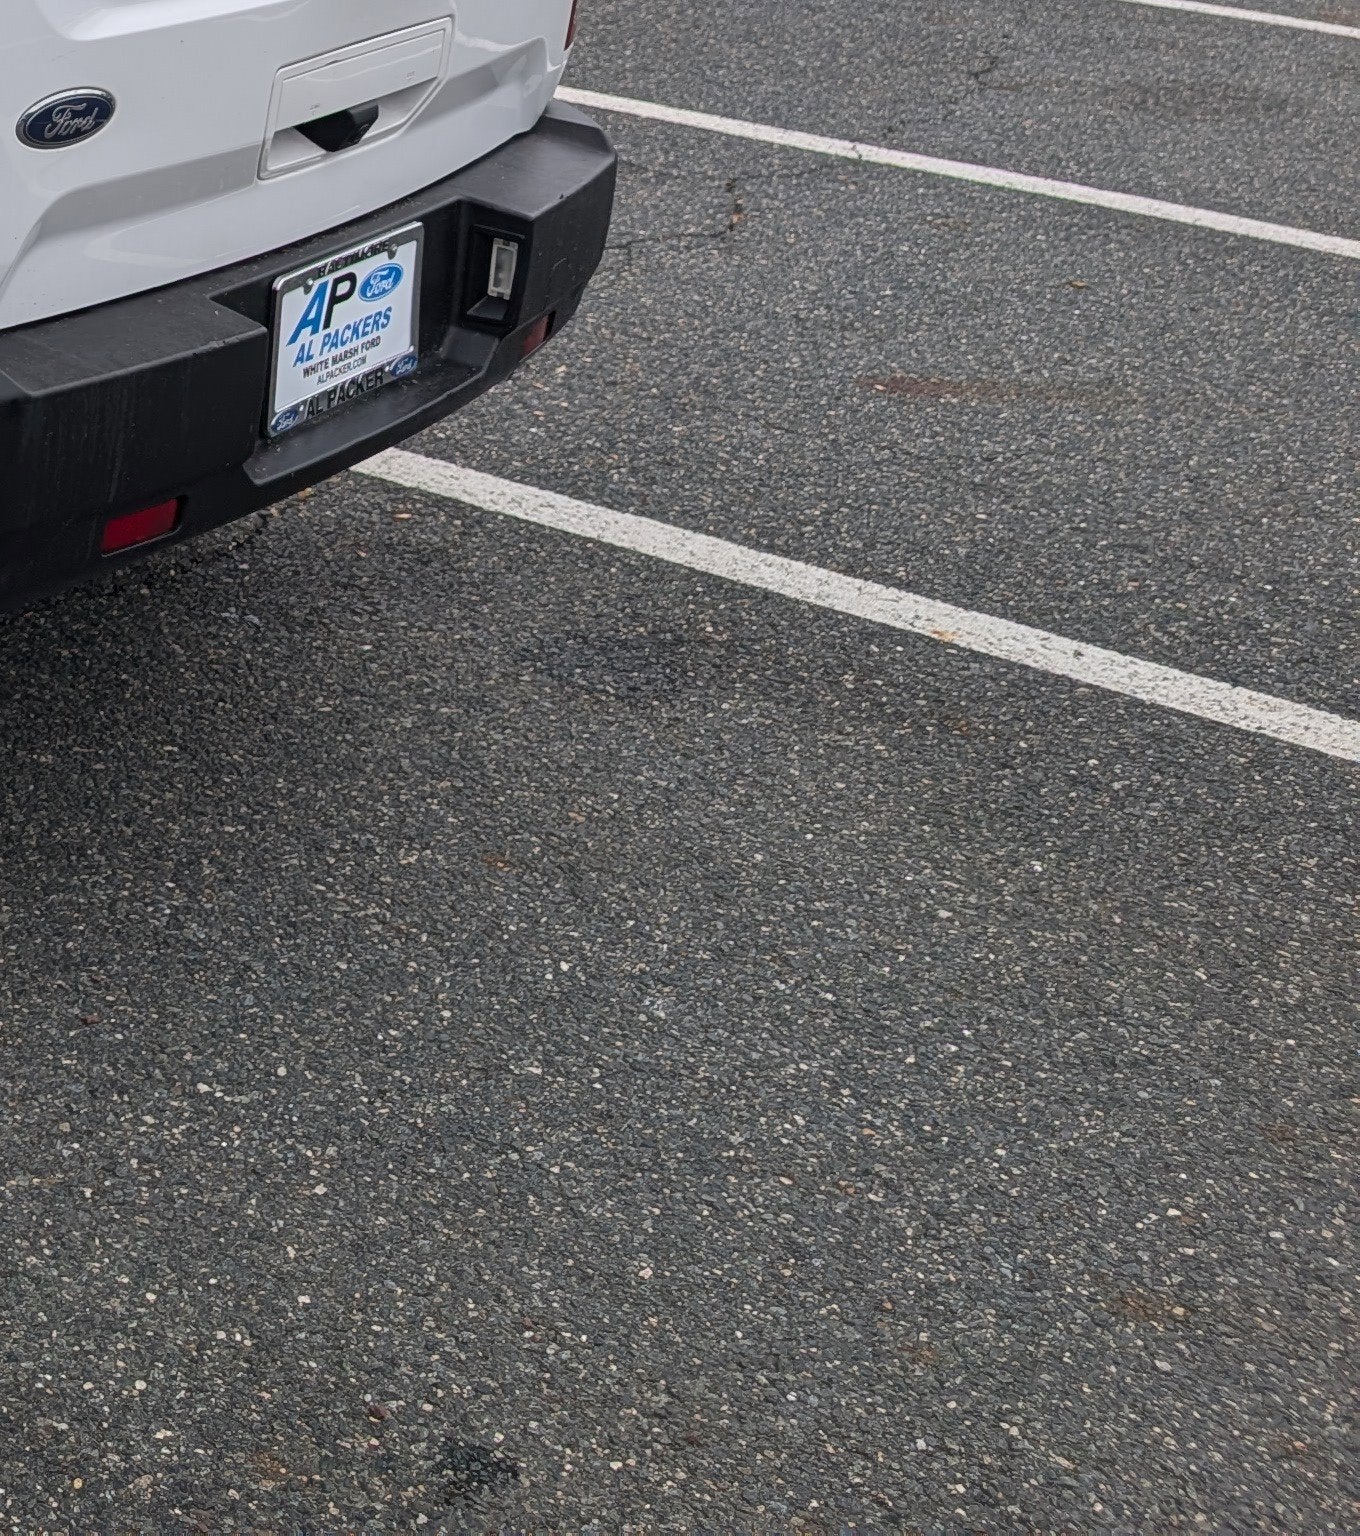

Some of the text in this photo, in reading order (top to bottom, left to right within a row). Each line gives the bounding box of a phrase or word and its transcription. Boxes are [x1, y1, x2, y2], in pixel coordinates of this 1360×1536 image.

[43, 102, 99, 140] Ford
[365, 268, 397, 297] Ford
[286, 271, 358, 347] AP
[293, 306, 392, 367] AL PACKERS
[302, 335, 382, 379] WHITE MARSH FORD
[316, 354, 368, 386] ALPACKER.COM
[305, 368, 384, 419] AL PACKER
